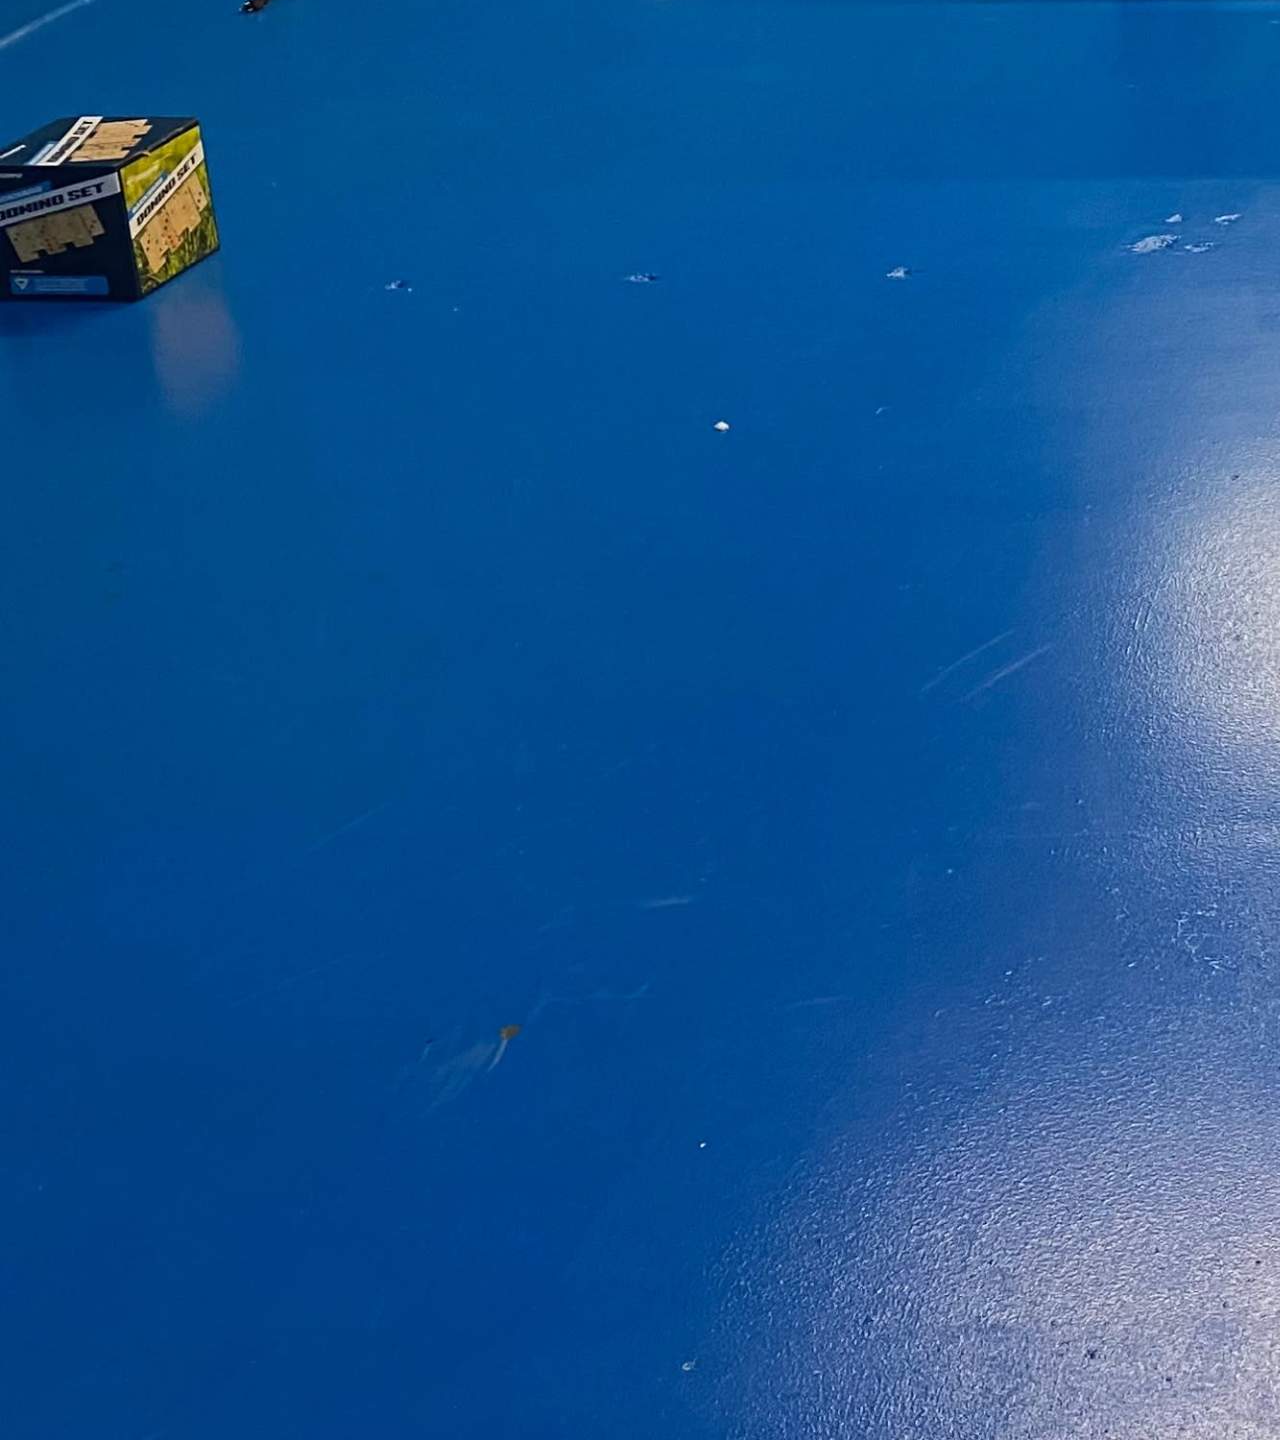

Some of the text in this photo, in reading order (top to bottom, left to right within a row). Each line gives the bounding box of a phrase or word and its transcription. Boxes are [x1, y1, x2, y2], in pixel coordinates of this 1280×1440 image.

[68, 181, 105, 202] SET
[136, 177, 177, 226] DOMINO
[176, 153, 197, 181] SET
